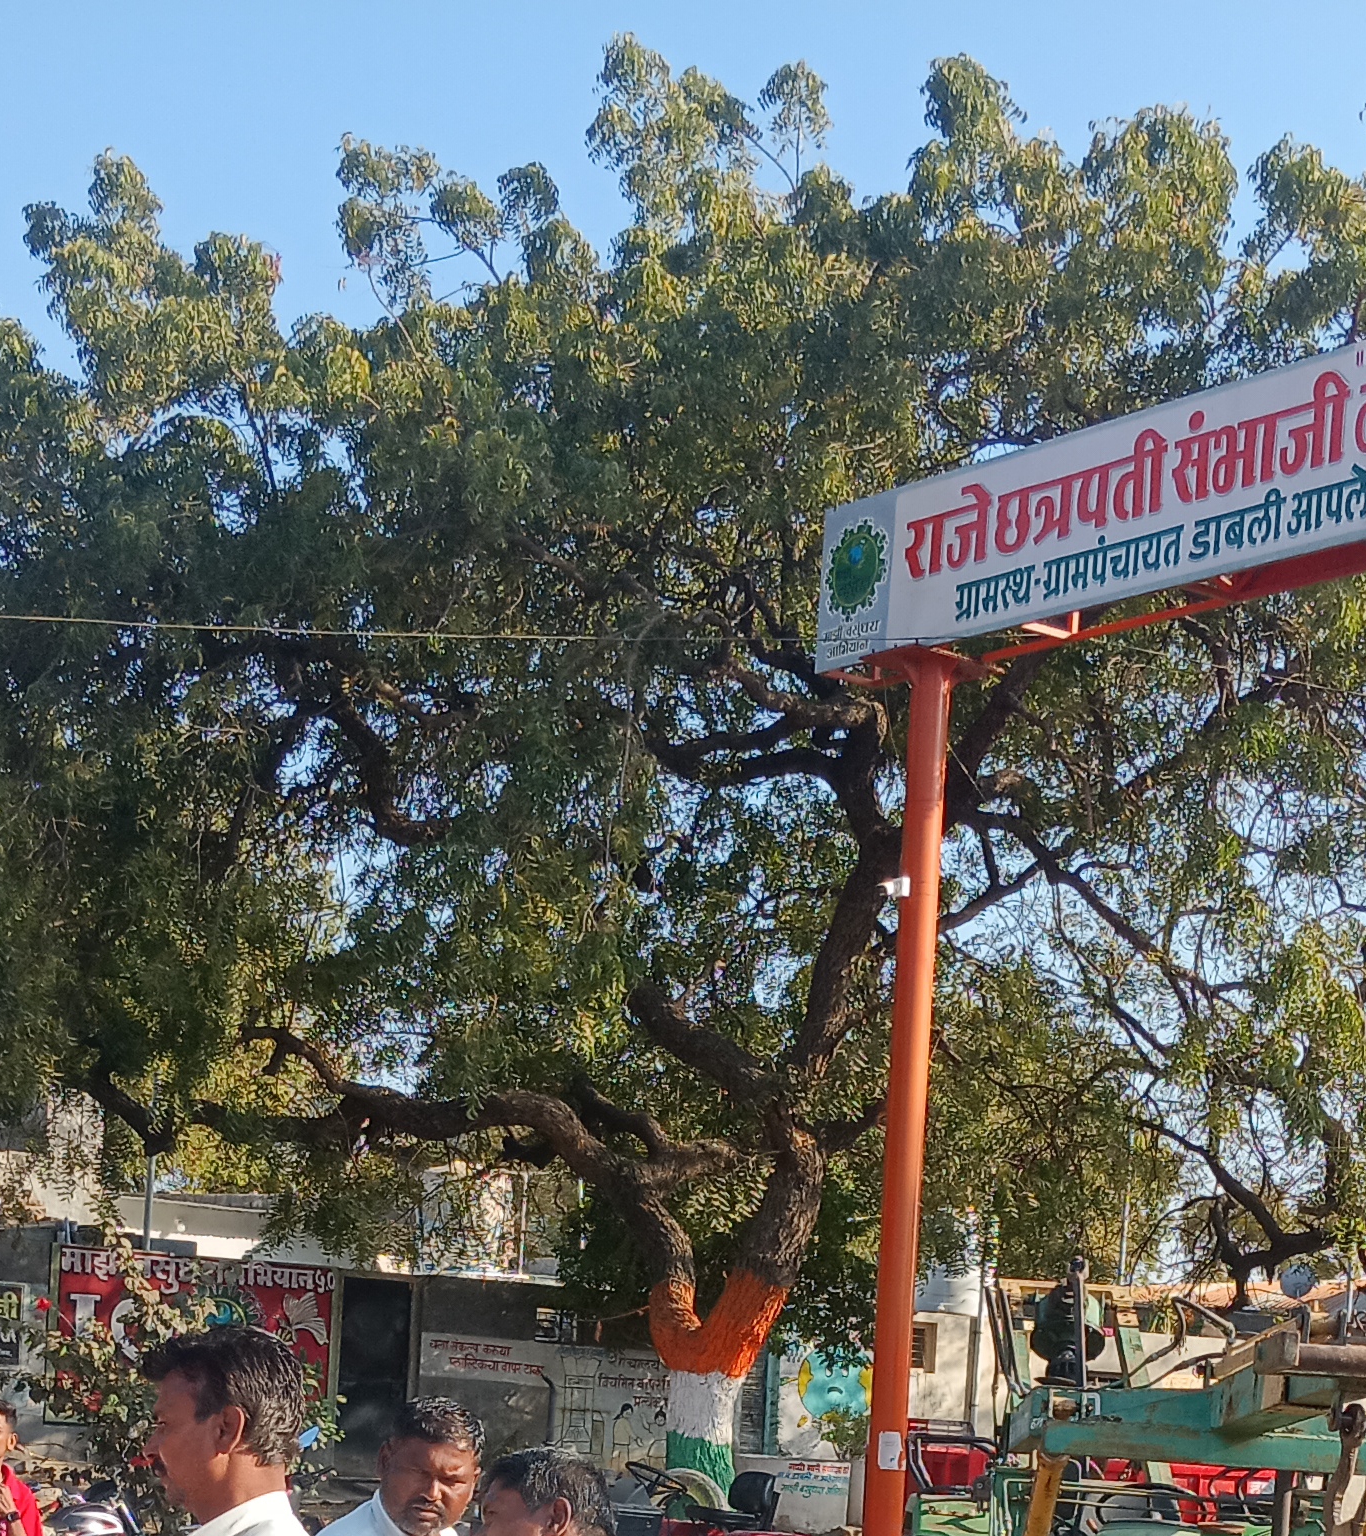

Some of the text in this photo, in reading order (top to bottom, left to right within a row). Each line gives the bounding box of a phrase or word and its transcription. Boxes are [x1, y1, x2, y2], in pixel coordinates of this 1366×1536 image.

[904, 483, 991, 581] राजे
[994, 429, 1169, 554] छत्रपती
[1171, 370, 1352, 504] संभाजी
[1189, 488, 1288, 560] डाबली
[61, 1247, 121, 1281] माझ
